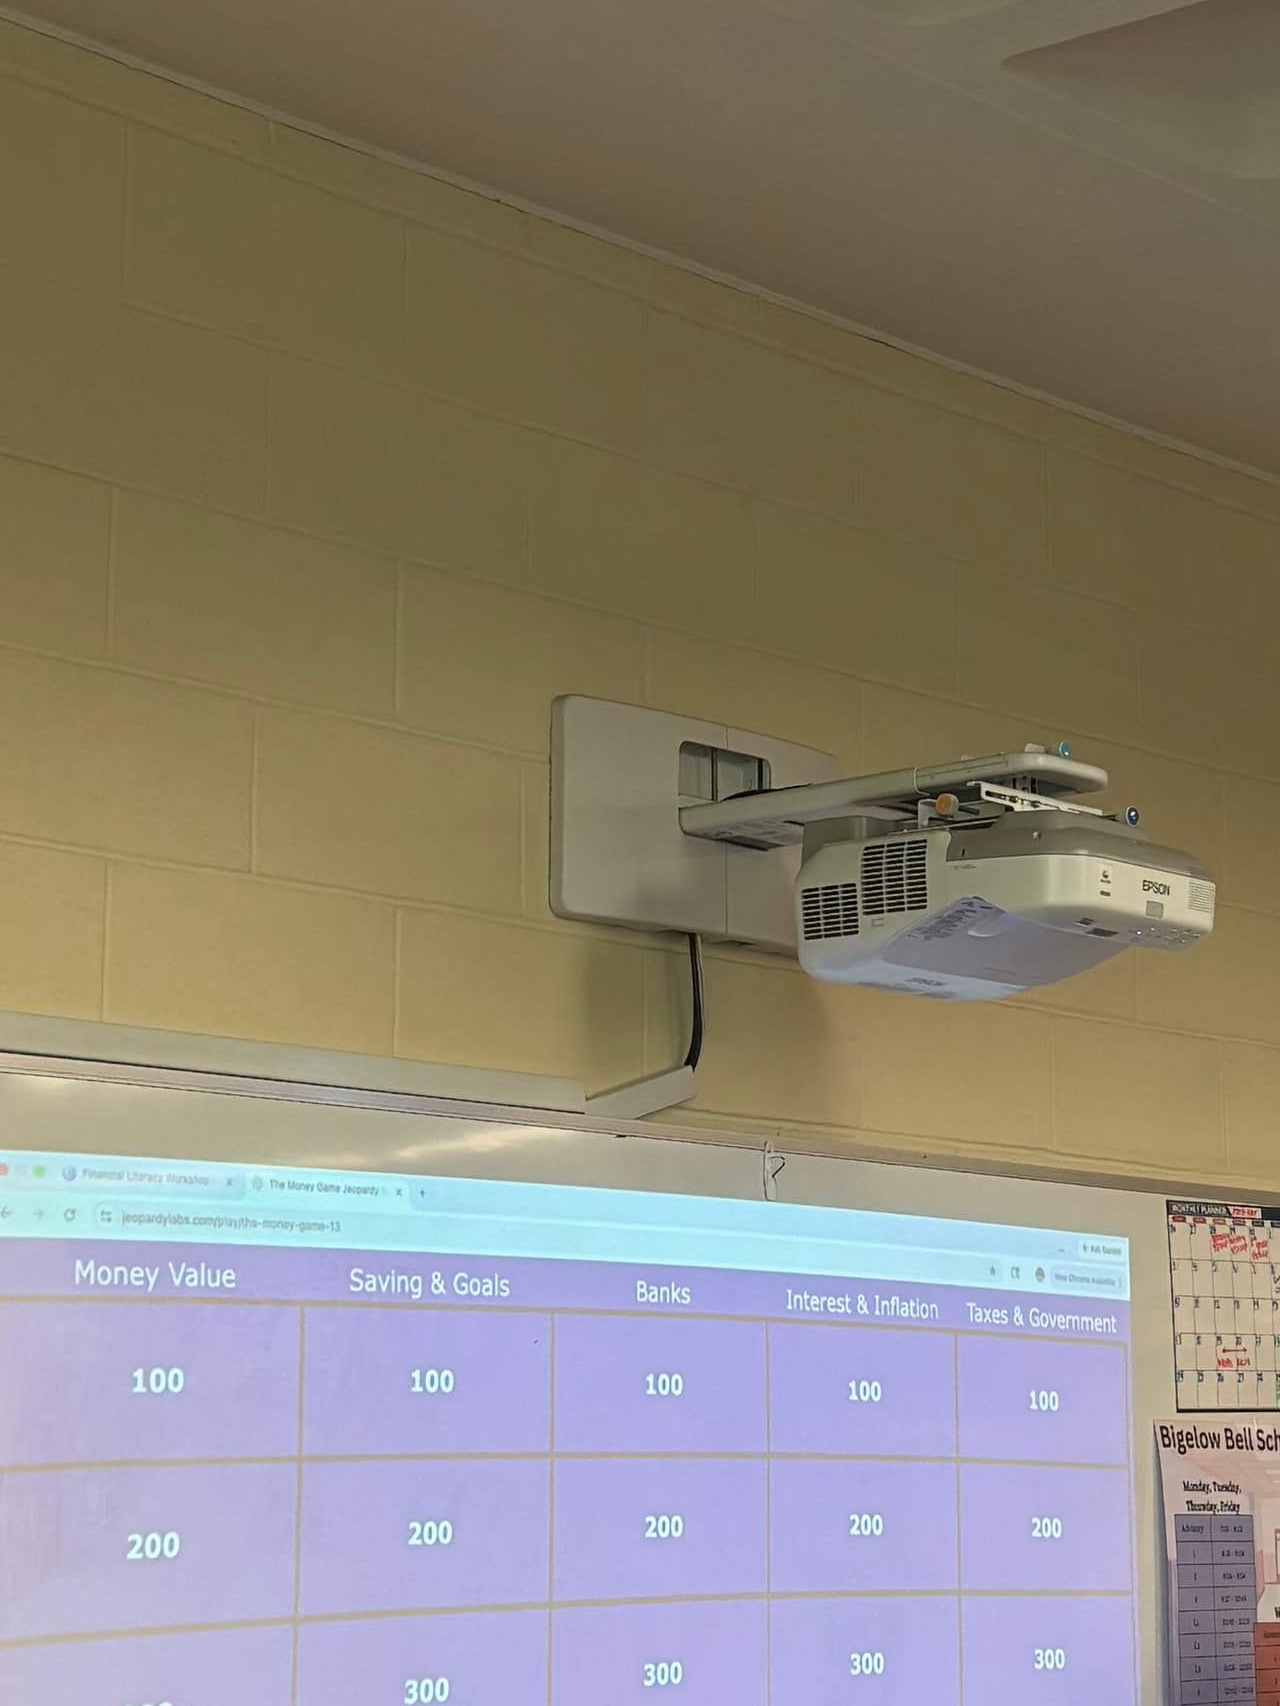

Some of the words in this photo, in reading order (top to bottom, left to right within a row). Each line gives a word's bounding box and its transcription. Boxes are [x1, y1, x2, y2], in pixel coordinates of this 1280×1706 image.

[1142, 879, 1170, 896] EPSON
[126, 1170, 164, 1185] Literacy
[269, 1178, 285, 1191] The
[287, 1180, 315, 1194] Money
[317, 1182, 341, 1194] Game
[343, 1184, 379, 1197] Jeopardy
[74, 1258, 160, 1292] Money
[168, 1260, 236, 1288] Value
[349, 1267, 422, 1299] Saving
[430, 1271, 447, 1295] &
[453, 1271, 511, 1297] Goals
[635, 1279, 691, 1305] Banks
[786, 1289, 852, 1316] Interest
[856, 1292, 869, 1315] &
[874, 1294, 939, 1320] Inflation
[966, 1301, 1008, 1325] Taxes
[1013, 1305, 1024, 1326] &
[1029, 1307, 1118, 1334] Government
[132, 1367, 184, 1393] 100
[411, 1369, 454, 1393] 100
[646, 1373, 683, 1396] 100
[849, 1380, 882, 1402] 100
[1029, 1390, 1059, 1411] 100
[1160, 1424, 1221, 1455] Bigelow
[1223, 1427, 1255, 1451] Bell
[1182, 1479, 1212, 1495] Monday,
[1212, 1480, 1242, 1496] Tuesday,
[1220, 1500, 1241, 1516] Friday
[407, 1520, 453, 1545] 200
[645, 1515, 683, 1538] 200
[849, 1513, 883, 1536] 200
[1031, 1517, 1062, 1539] 200
[126, 1531, 180, 1560] 200
[850, 1652, 885, 1675] 300
[1034, 1648, 1066, 1670] 300
[643, 1661, 683, 1687] 300
[404, 1677, 449, 1705] 300
